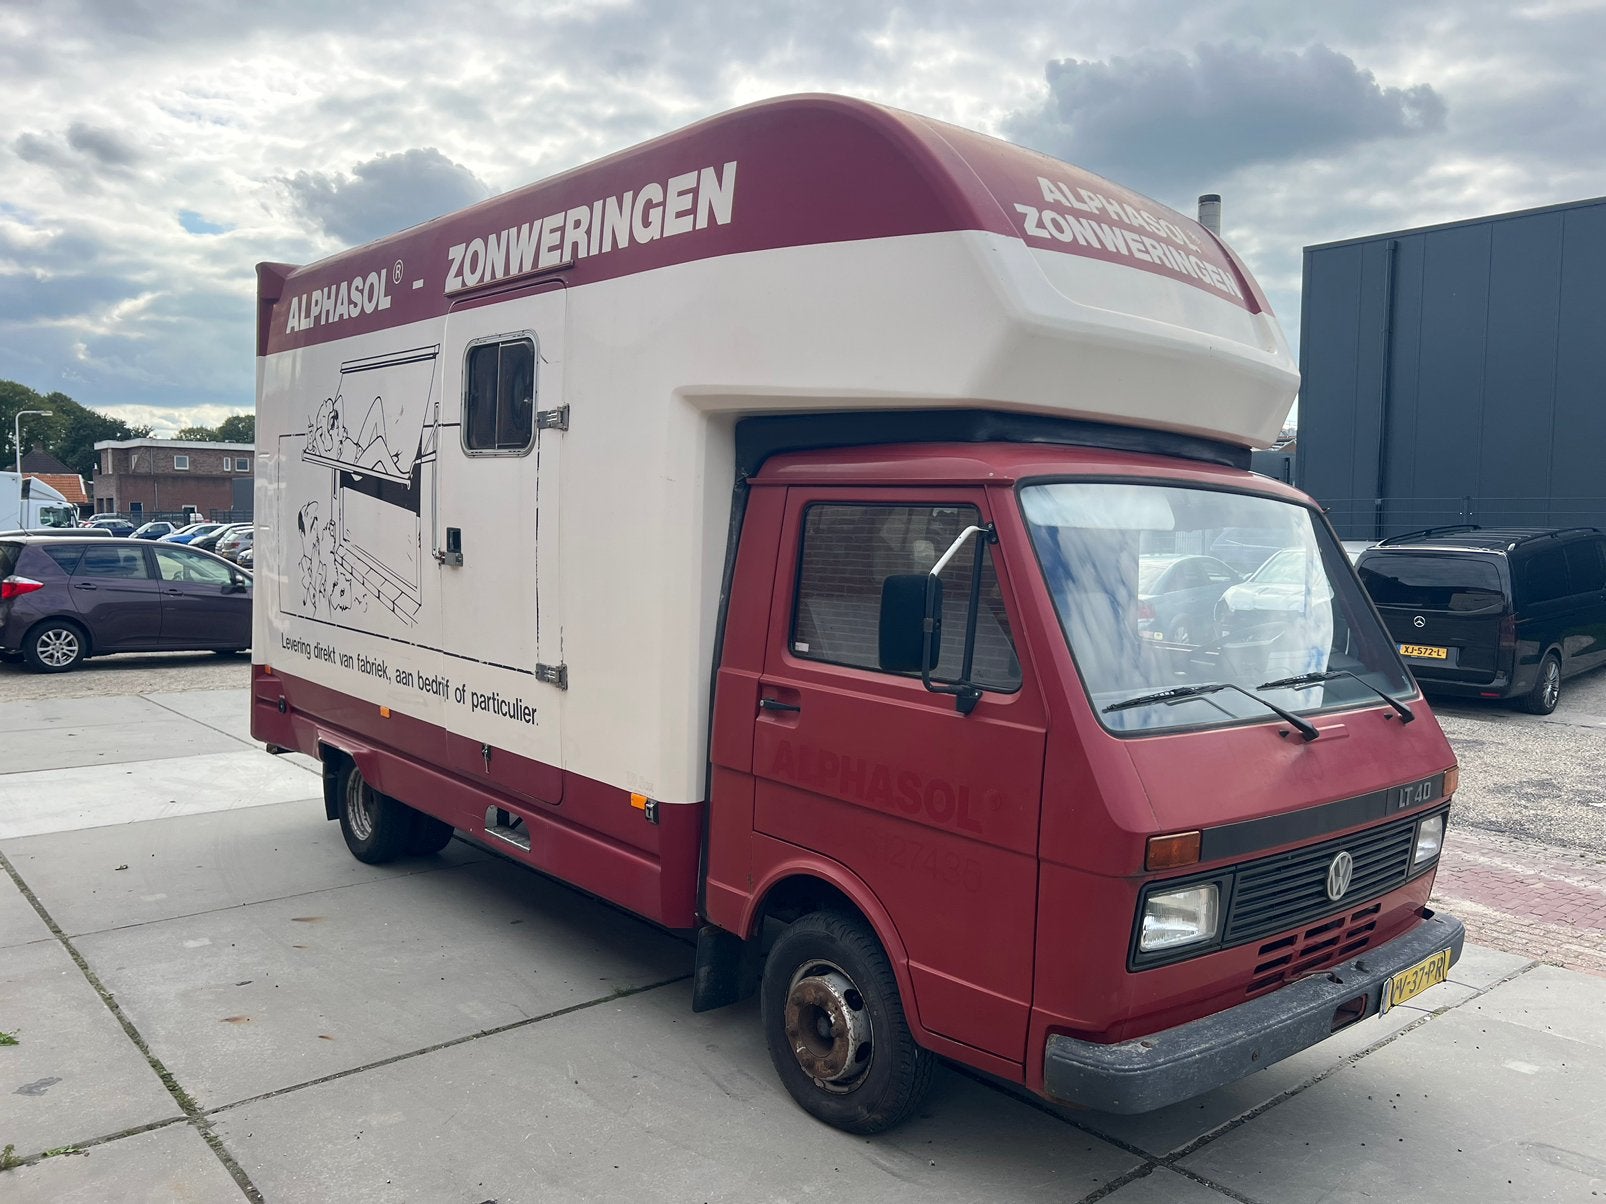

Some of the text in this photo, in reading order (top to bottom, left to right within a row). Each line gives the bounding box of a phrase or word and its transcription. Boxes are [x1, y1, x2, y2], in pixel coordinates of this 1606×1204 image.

[444, 161, 737, 294] ZONWERINGEN
[1013, 203, 1245, 299] ZONWERINGEN
[281, 632, 539, 727] Levering direkt van fabriek, aan bedrijf of particulier.
[1403, 645, 1442, 657] XJ-572-L
[1399, 782, 1431, 808] LT 40
